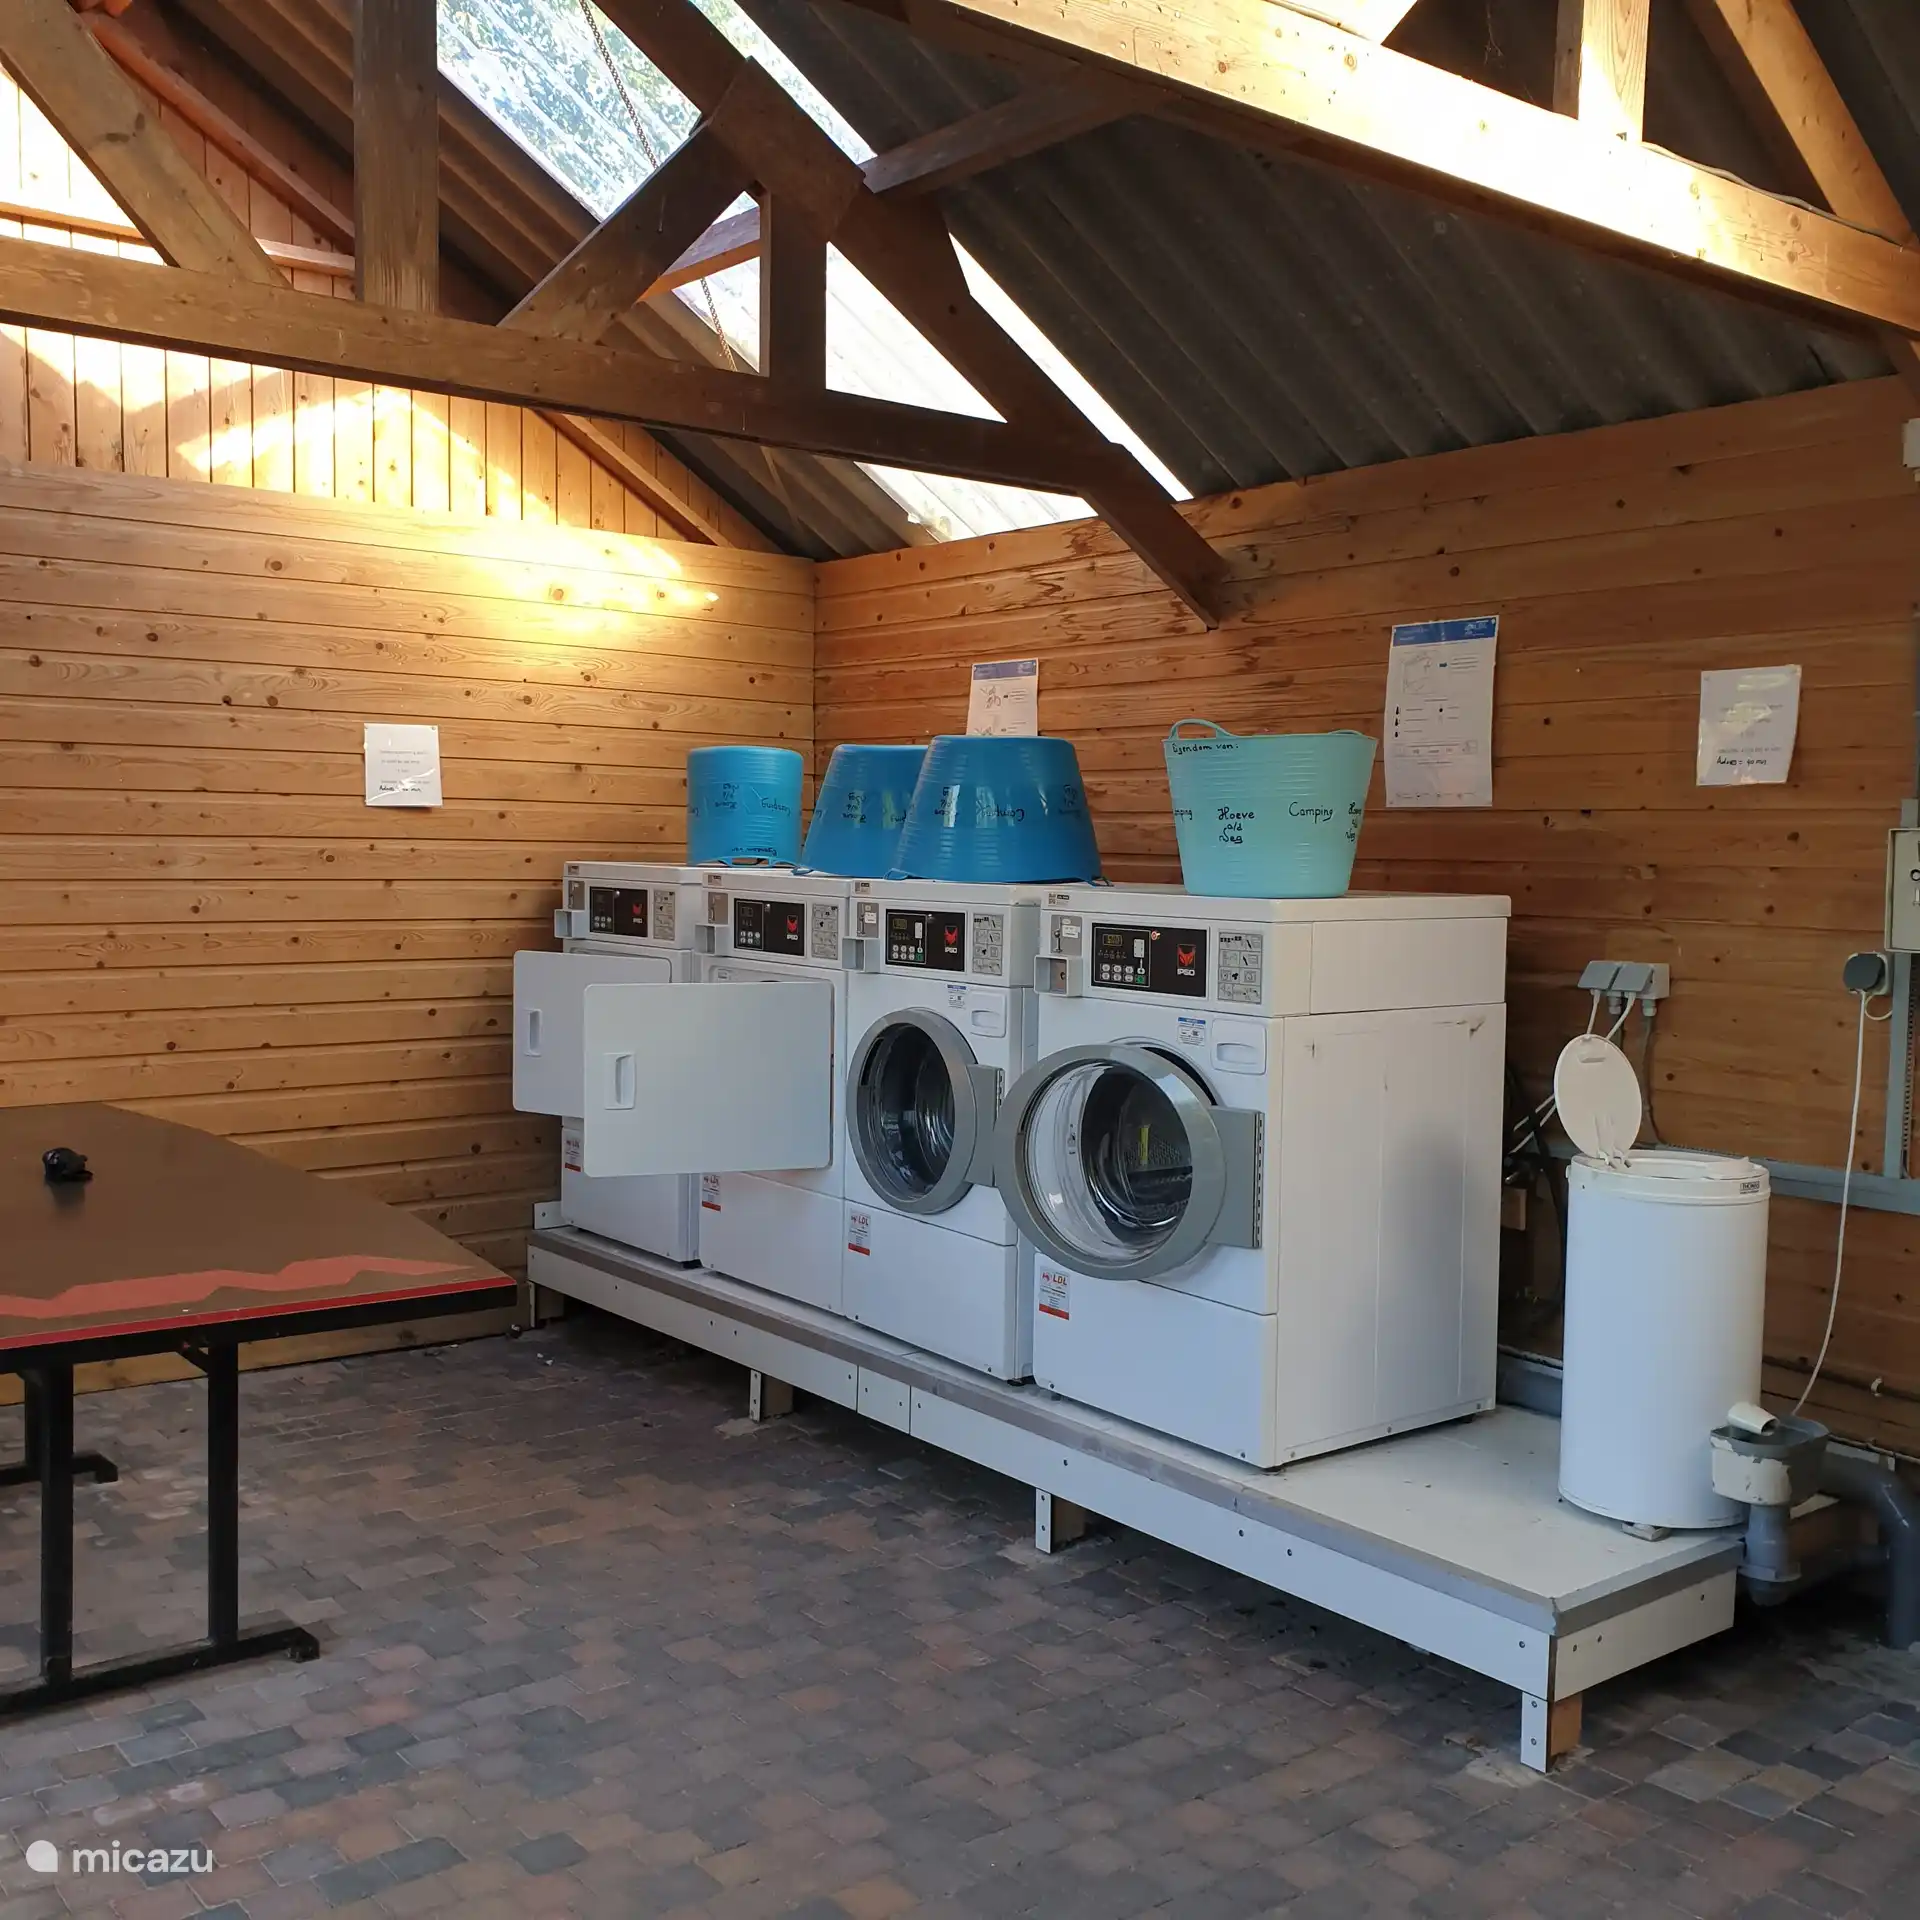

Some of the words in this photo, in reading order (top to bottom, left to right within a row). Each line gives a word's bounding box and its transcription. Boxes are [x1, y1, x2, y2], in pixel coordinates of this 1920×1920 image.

[1217, 806, 1255, 820] Hoeve
[1288, 801, 1334, 824] Camping
[1227, 822, 1243, 831] a/d
[1053, 1273, 1067, 1285] LDL
